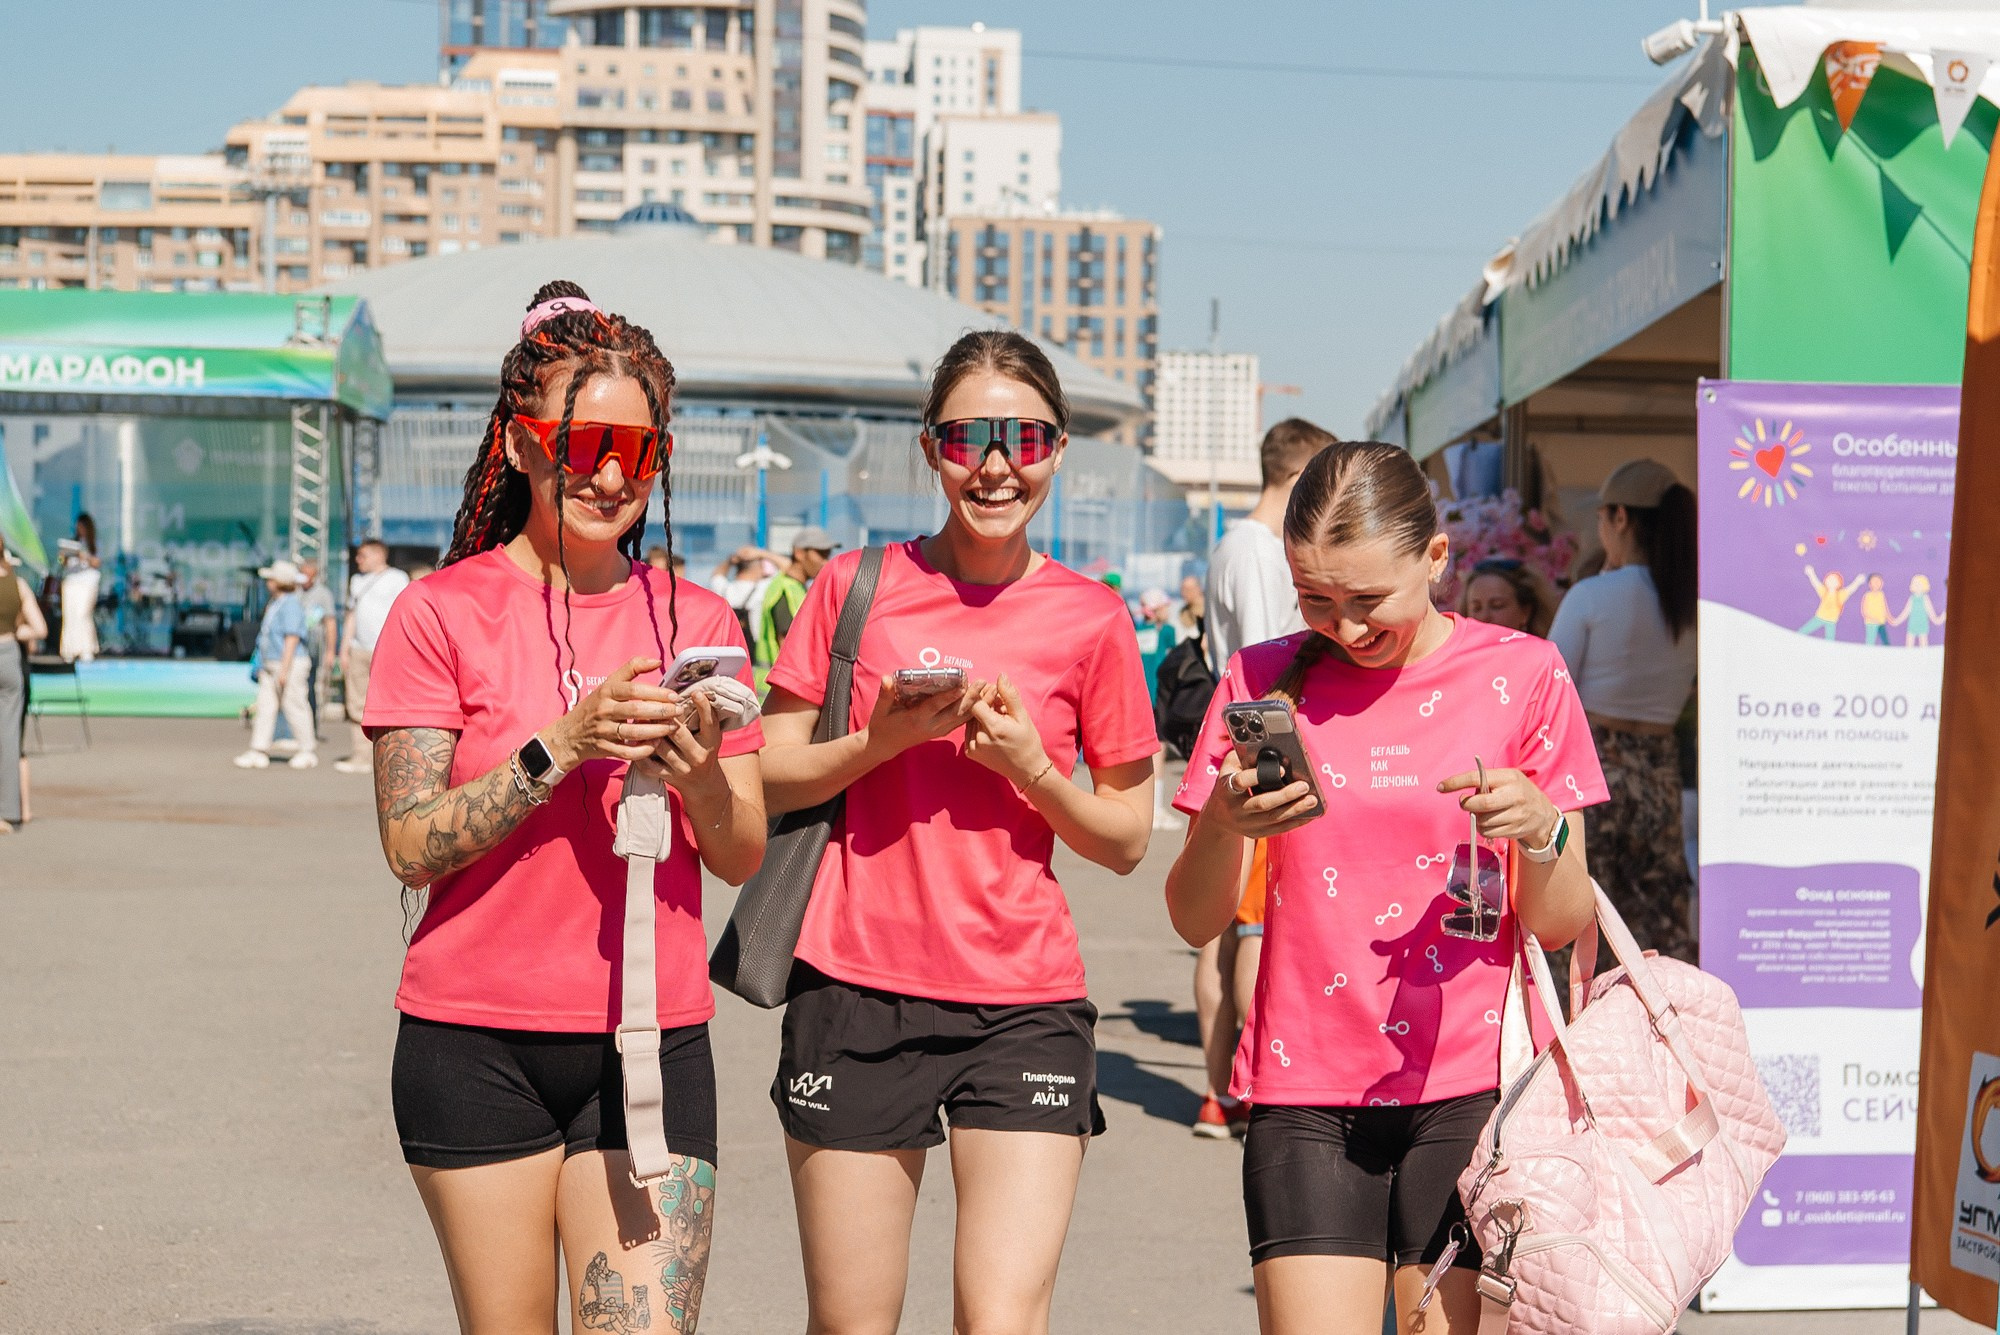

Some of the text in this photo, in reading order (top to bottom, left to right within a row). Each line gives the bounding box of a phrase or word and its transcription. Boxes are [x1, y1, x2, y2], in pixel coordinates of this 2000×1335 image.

[0, 354, 205, 387] МАРАФОН
[943, 655, 974, 669] БЕГАЕШЬ
[1738, 694, 1821, 718] Более
[1833, 694, 1909, 718] 2000
[1737, 728, 1909, 744] получили помощь
[1370, 744, 1411, 757] БЕГАЕШЬ
[1370, 760, 1389, 772] КАК
[1370, 775, 1420, 790] ДЕВЧОНКА
[1796, 886, 1834, 903] Фонд
[1022, 1071, 1076, 1085] Платформа
[1843, 1063, 1919, 1087] Помо
[788, 1095, 831, 1111] MAD WILL
[1031, 1091, 1069, 1107] AVLN
[1958, 1199, 2000, 1234] УГМ
[1956, 1236, 2000, 1264] ЗАСТРОЙ
